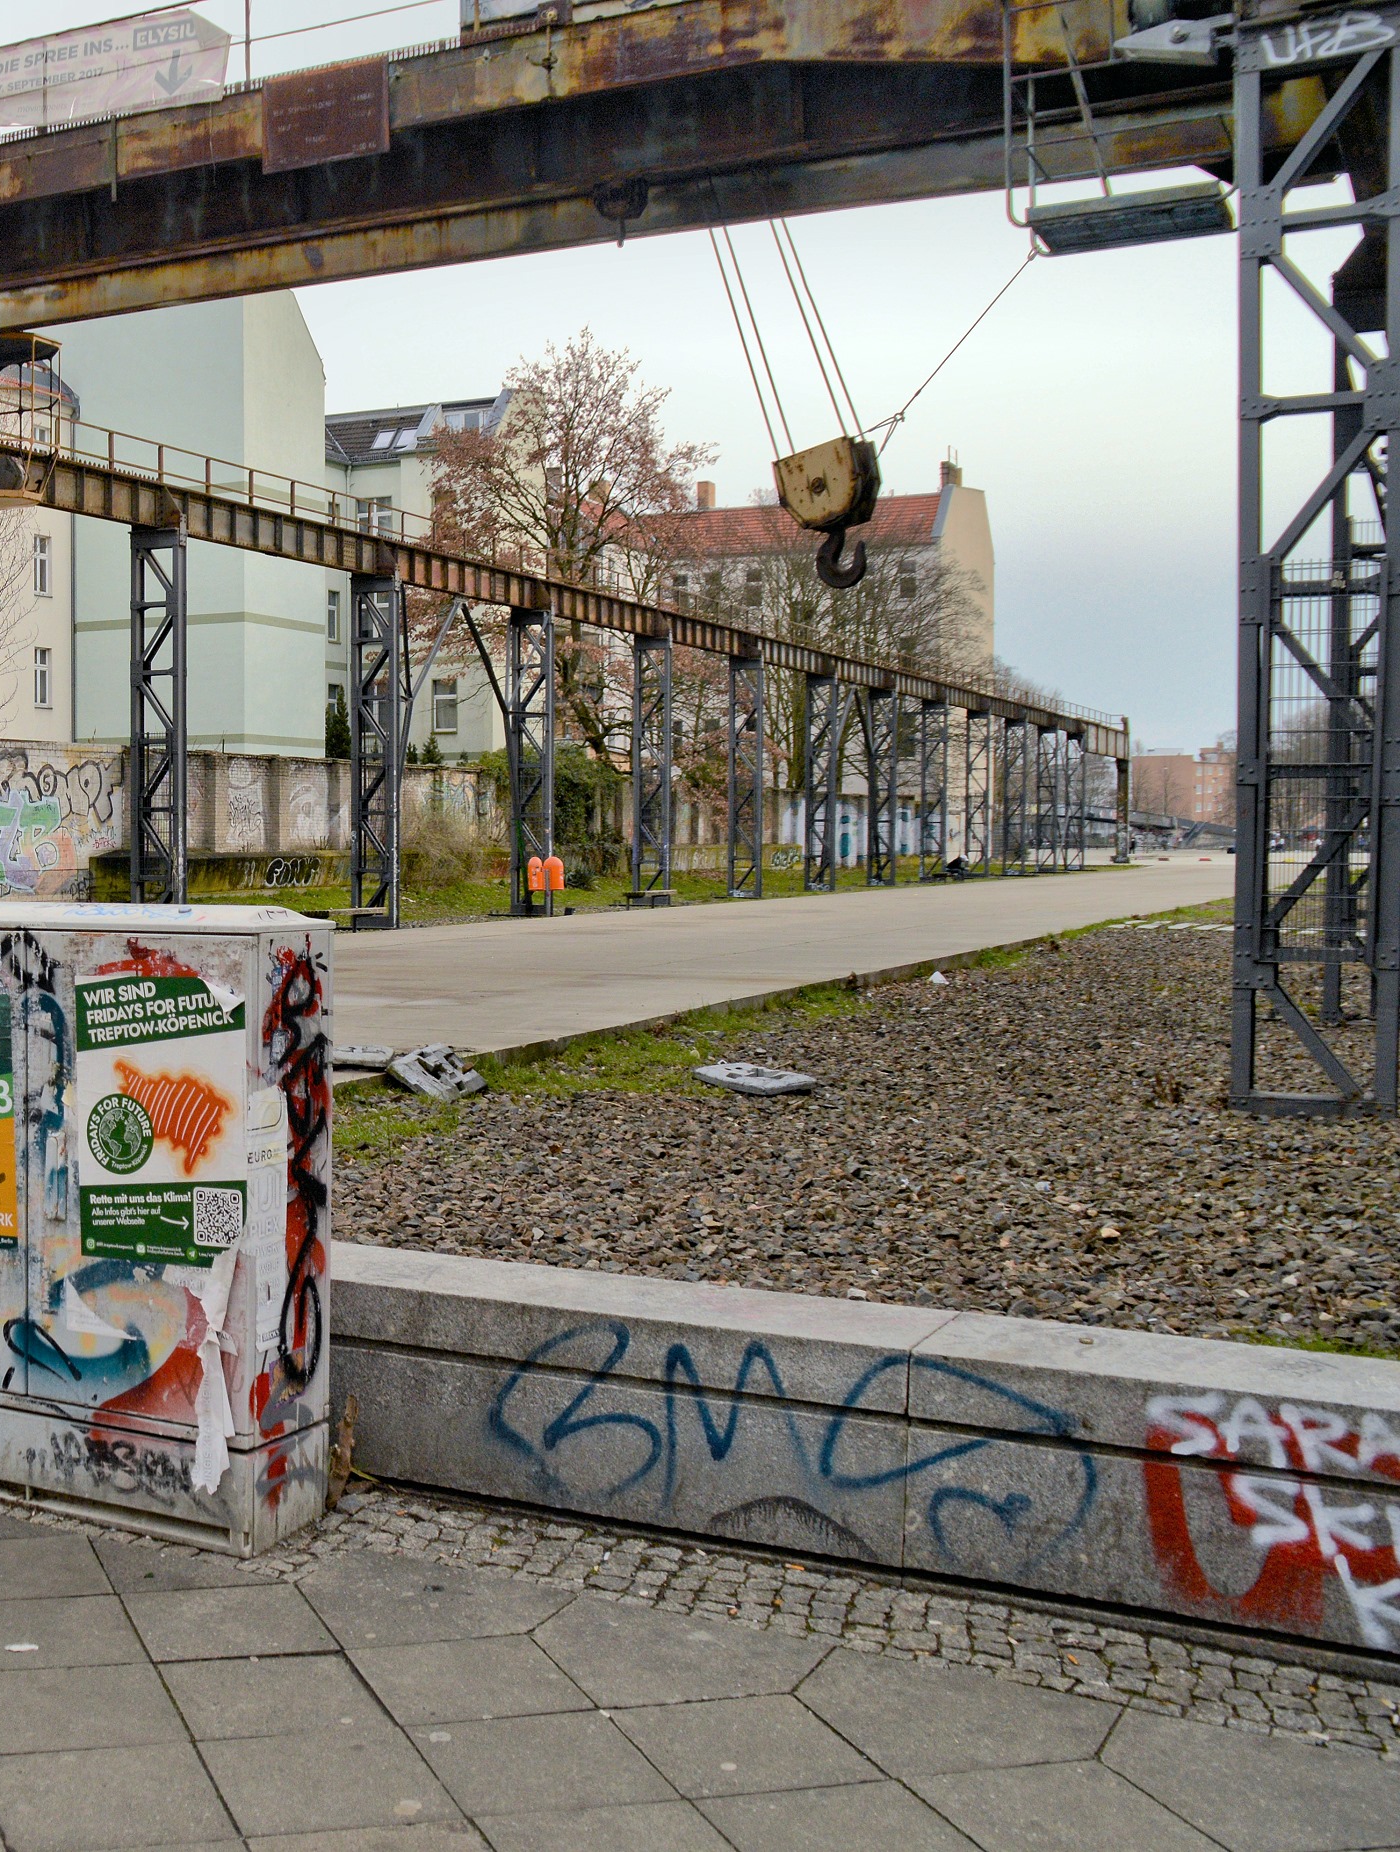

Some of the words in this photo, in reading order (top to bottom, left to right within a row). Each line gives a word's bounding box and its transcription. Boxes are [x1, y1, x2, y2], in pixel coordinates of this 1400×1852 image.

[23, 43, 80, 70] SPREE
[137, 20, 198, 49] ELYSIU
[7, 71, 76, 93] SEPTEMBER
[78, 66, 105, 81] 2017
[83, 987, 117, 1007] WIR
[118, 981, 157, 1002] SIND
[86, 1002, 144, 1026] FRIDAYS
[146, 998, 177, 1017] FOR
[177, 992, 220, 1012] FUTU
[87, 1010, 235, 1044] TREPTOW-KÖPENICK
[96, 1096, 120, 1116] FOR
[121, 1097, 152, 1138] FUTURE
[89, 1113, 111, 1167] FRIDAYS
[89, 1193, 113, 1205] Rette
[114, 1193, 128, 1205] mit
[129, 1193, 145, 1204] uns
[146, 1191, 163, 1204] das
[163, 1191, 192, 1203] Klima!
[91, 1206, 104, 1216] Alle
[104, 1206, 120, 1216] Infos
[120, 1205, 137, 1219] gibt's
[137, 1205, 149, 1216] hier
[150, 1205, 161, 1215] auf
[92, 1218, 116, 1227] unserer
[117, 1216, 146, 1226] Webseite
